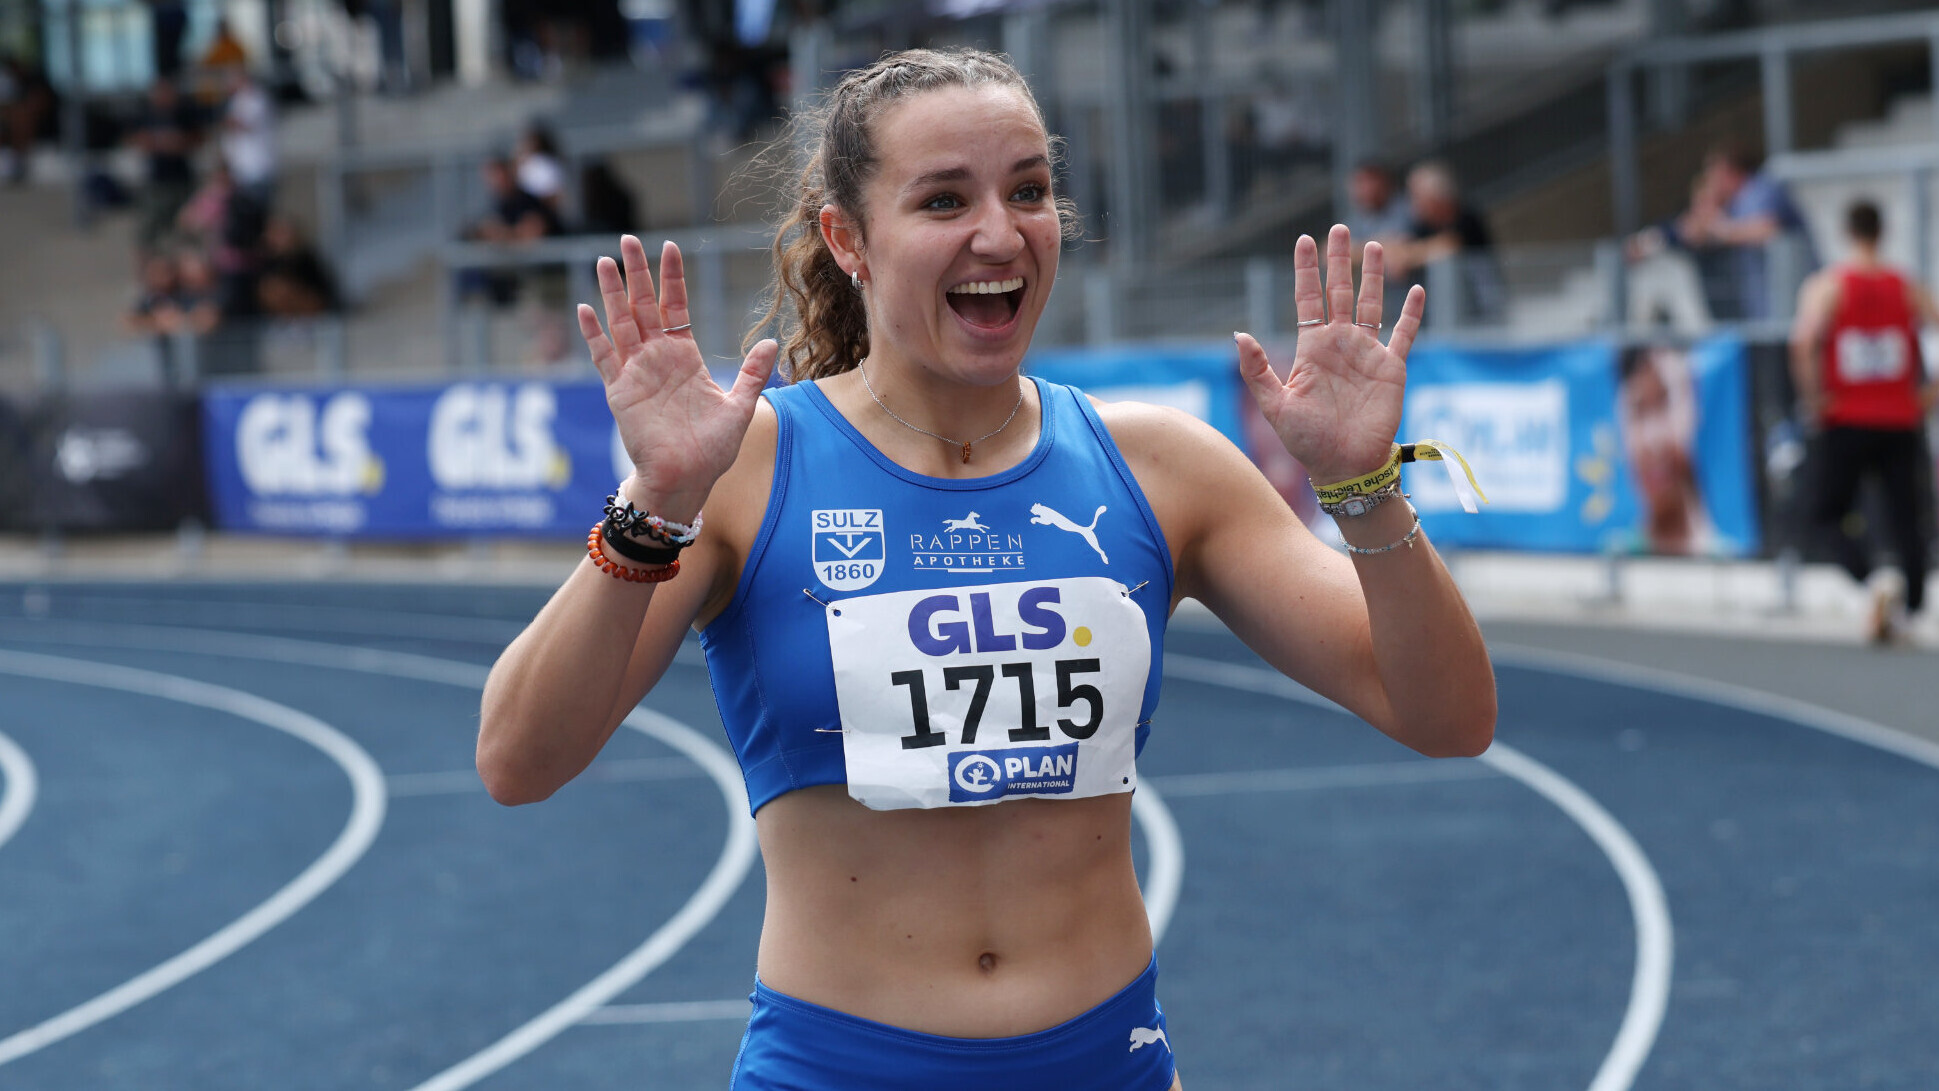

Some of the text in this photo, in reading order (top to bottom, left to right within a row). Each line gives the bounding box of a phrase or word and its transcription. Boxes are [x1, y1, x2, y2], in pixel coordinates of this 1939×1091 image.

[816, 512, 879, 529] SULZ
[910, 533, 1023, 551] RAPPEN
[914, 555, 1025, 567] APOTHEKE
[823, 563, 875, 582] 1860
[891, 658, 1104, 750] 1715
[1005, 754, 1074, 779] PLAN
[1007, 780, 1071, 790] INTERNATIONAL
